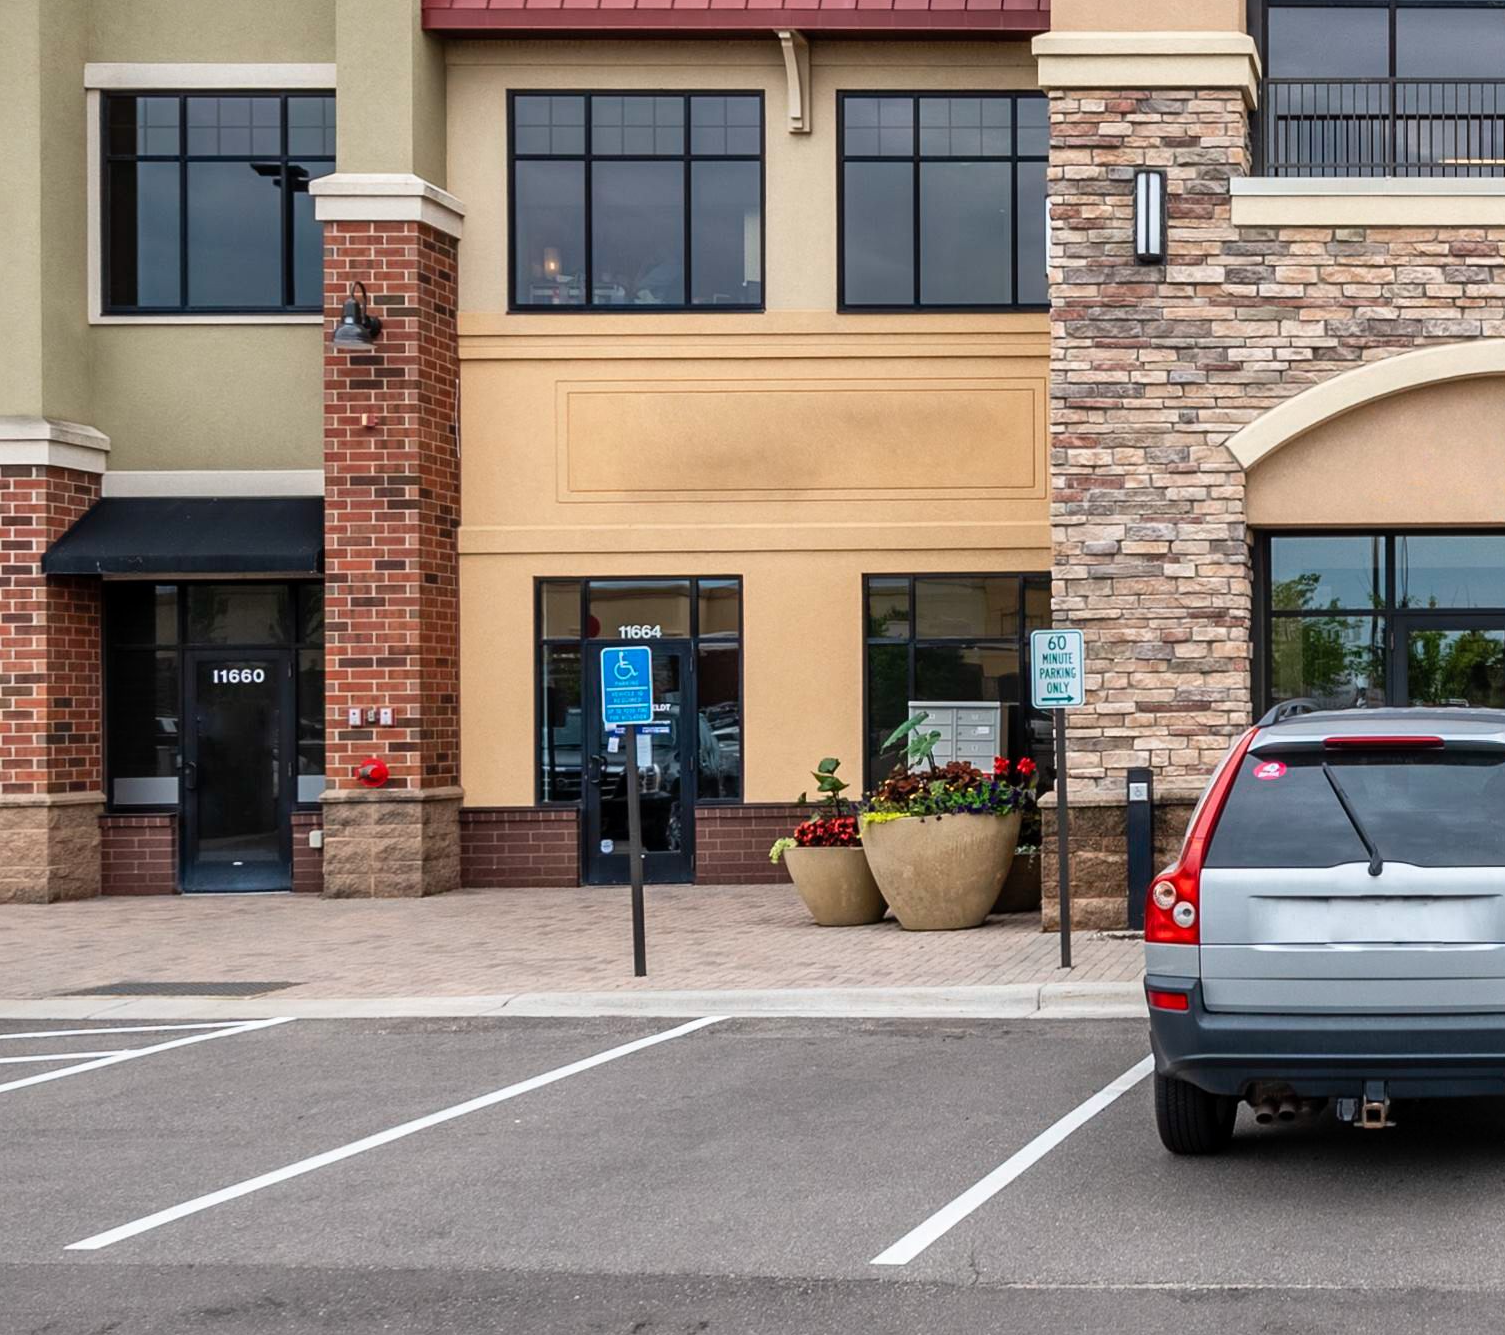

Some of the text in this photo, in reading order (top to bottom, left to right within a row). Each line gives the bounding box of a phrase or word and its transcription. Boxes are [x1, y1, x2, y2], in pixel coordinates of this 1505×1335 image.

[618, 625, 662, 639] 11664
[1048, 635, 1067, 651] 60
[1042, 652, 1073, 664] MINUTE
[1039, 667, 1077, 679] PARKING
[1046, 681, 1070, 694] ONLY
